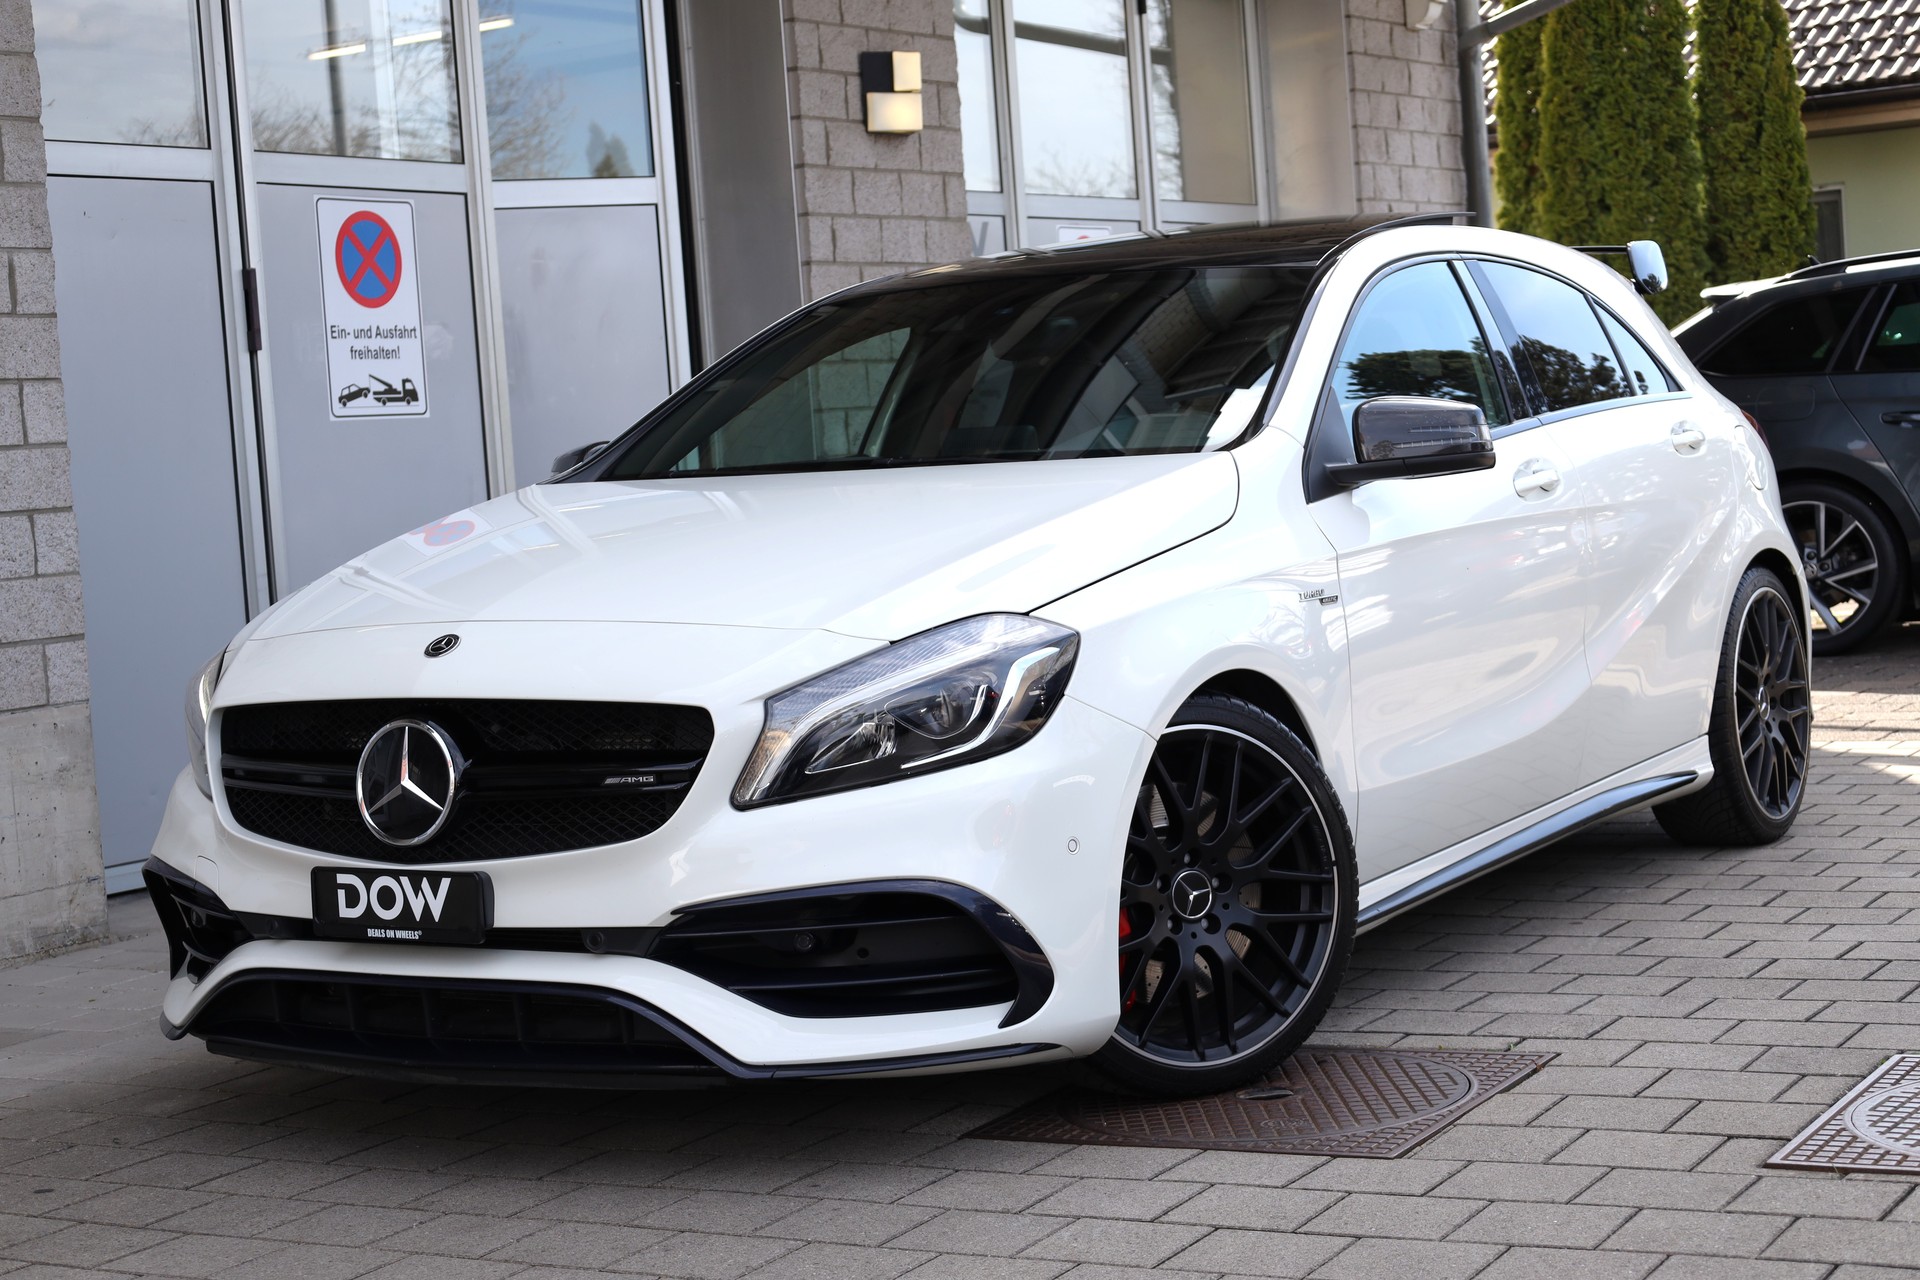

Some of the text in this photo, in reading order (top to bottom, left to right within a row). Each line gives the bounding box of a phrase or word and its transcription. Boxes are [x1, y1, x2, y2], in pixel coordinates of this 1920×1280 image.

[330, 325, 417, 340] Ein- und Ausfahrt
[350, 345, 401, 360] freihalten!
[336, 873, 451, 923] DOW
[367, 928, 386, 938] DEALS
[386, 929, 395, 938] ON
